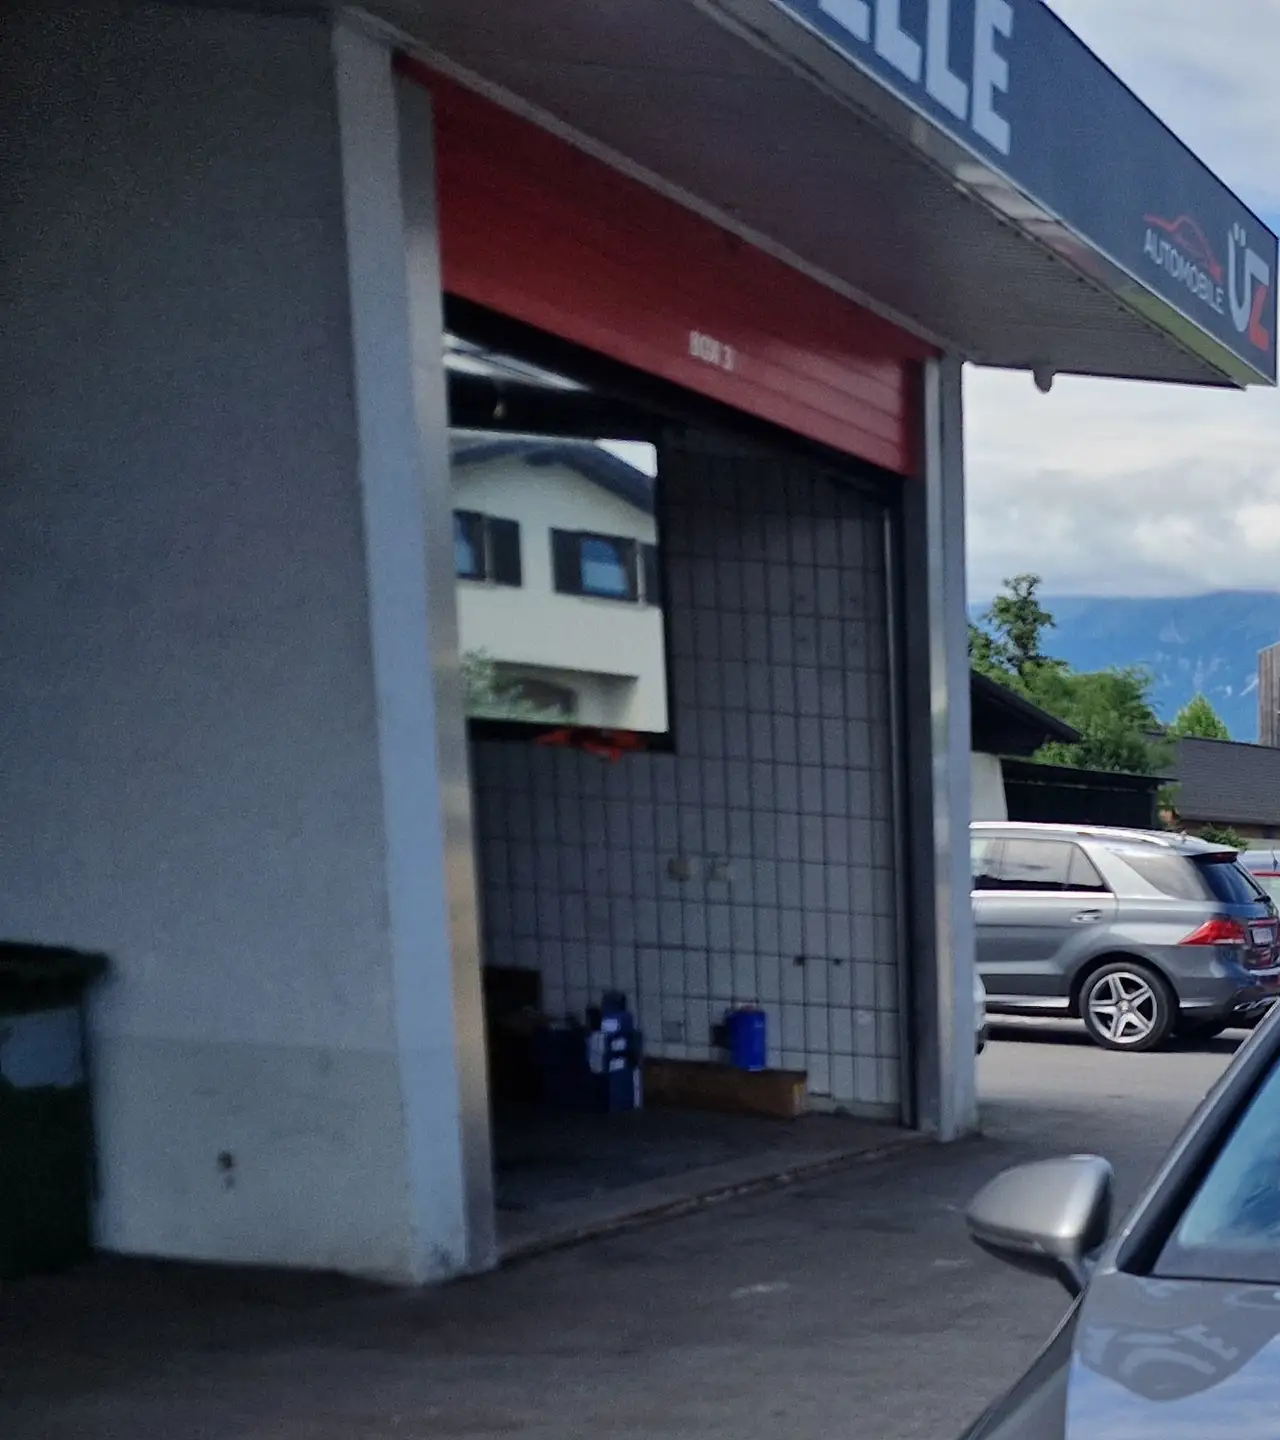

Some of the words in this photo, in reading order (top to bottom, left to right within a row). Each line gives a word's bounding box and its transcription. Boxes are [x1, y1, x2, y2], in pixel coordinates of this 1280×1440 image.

[817, 0, 1014, 156] LLE
[1144, 228, 1225, 316] AUTOMOBILE
[1228, 221, 1271, 353] ÜZ
